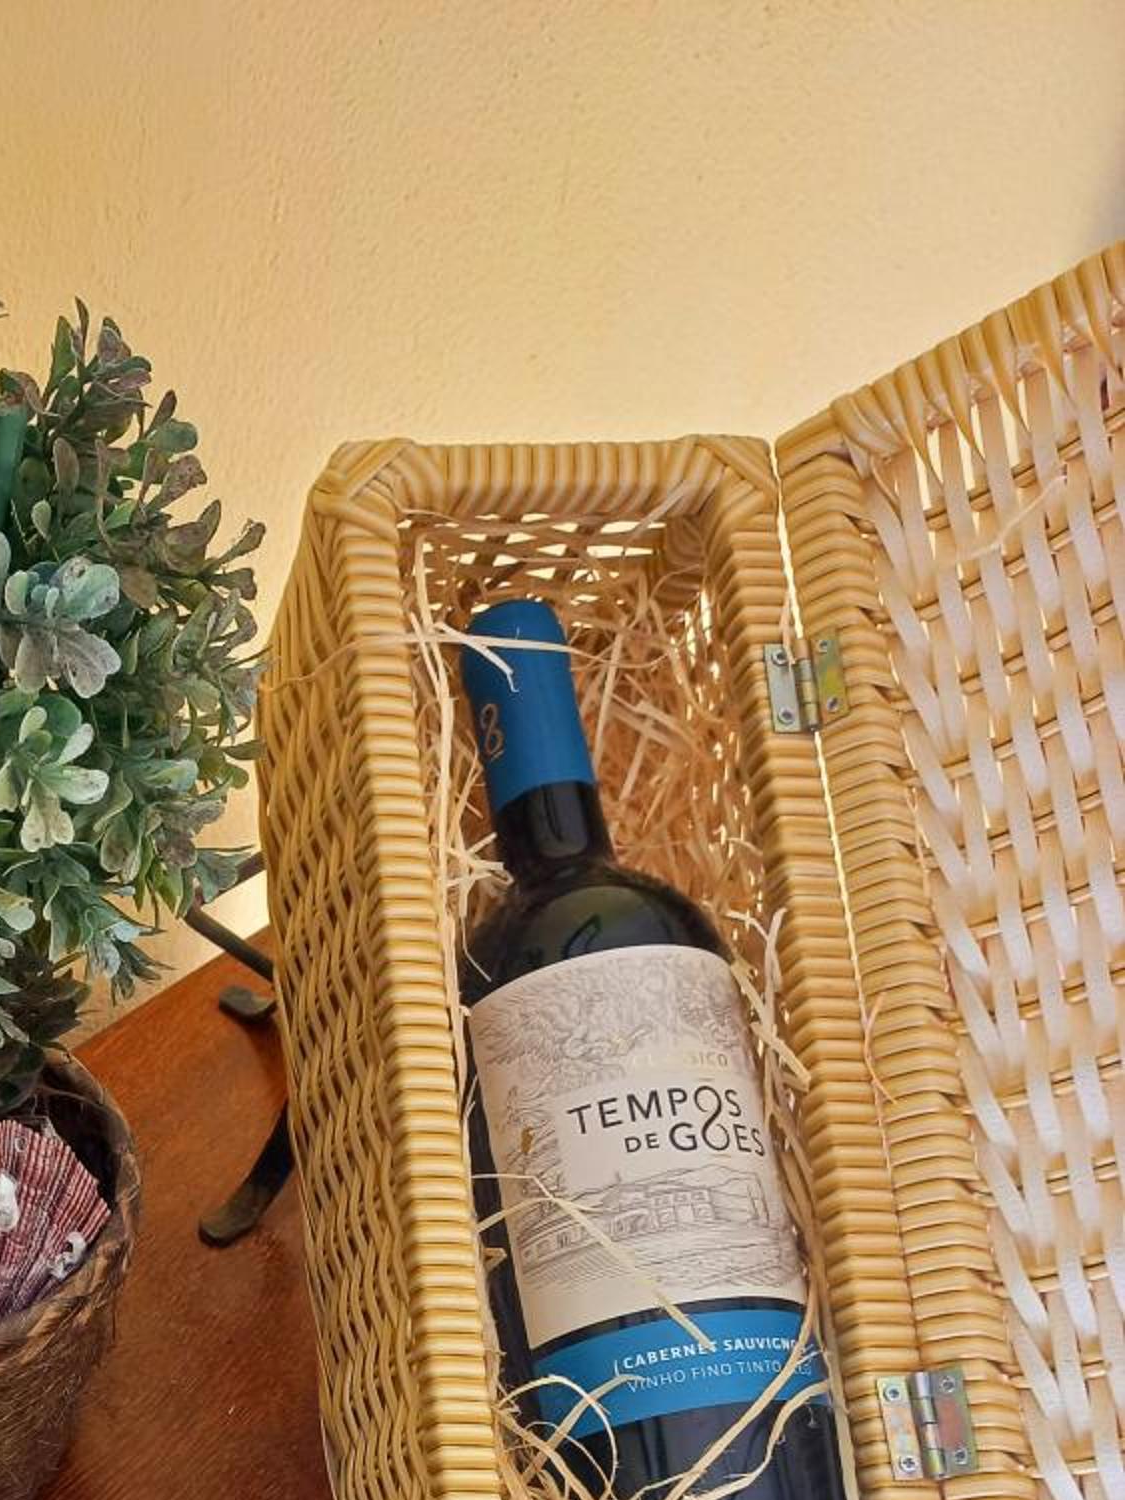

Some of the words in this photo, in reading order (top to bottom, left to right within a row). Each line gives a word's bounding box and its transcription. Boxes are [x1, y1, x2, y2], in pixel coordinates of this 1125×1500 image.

[566, 1085, 742, 1134] TEMPOS
[624, 1133, 660, 1153] DE
[623, 1341, 718, 1369] CABERNET
[724, 1337, 798, 1352] SAUVIGNO
[625, 1369, 687, 1393] VINHO
[691, 1360, 733, 1379] FINO
[737, 1360, 781, 1375] TINTO
